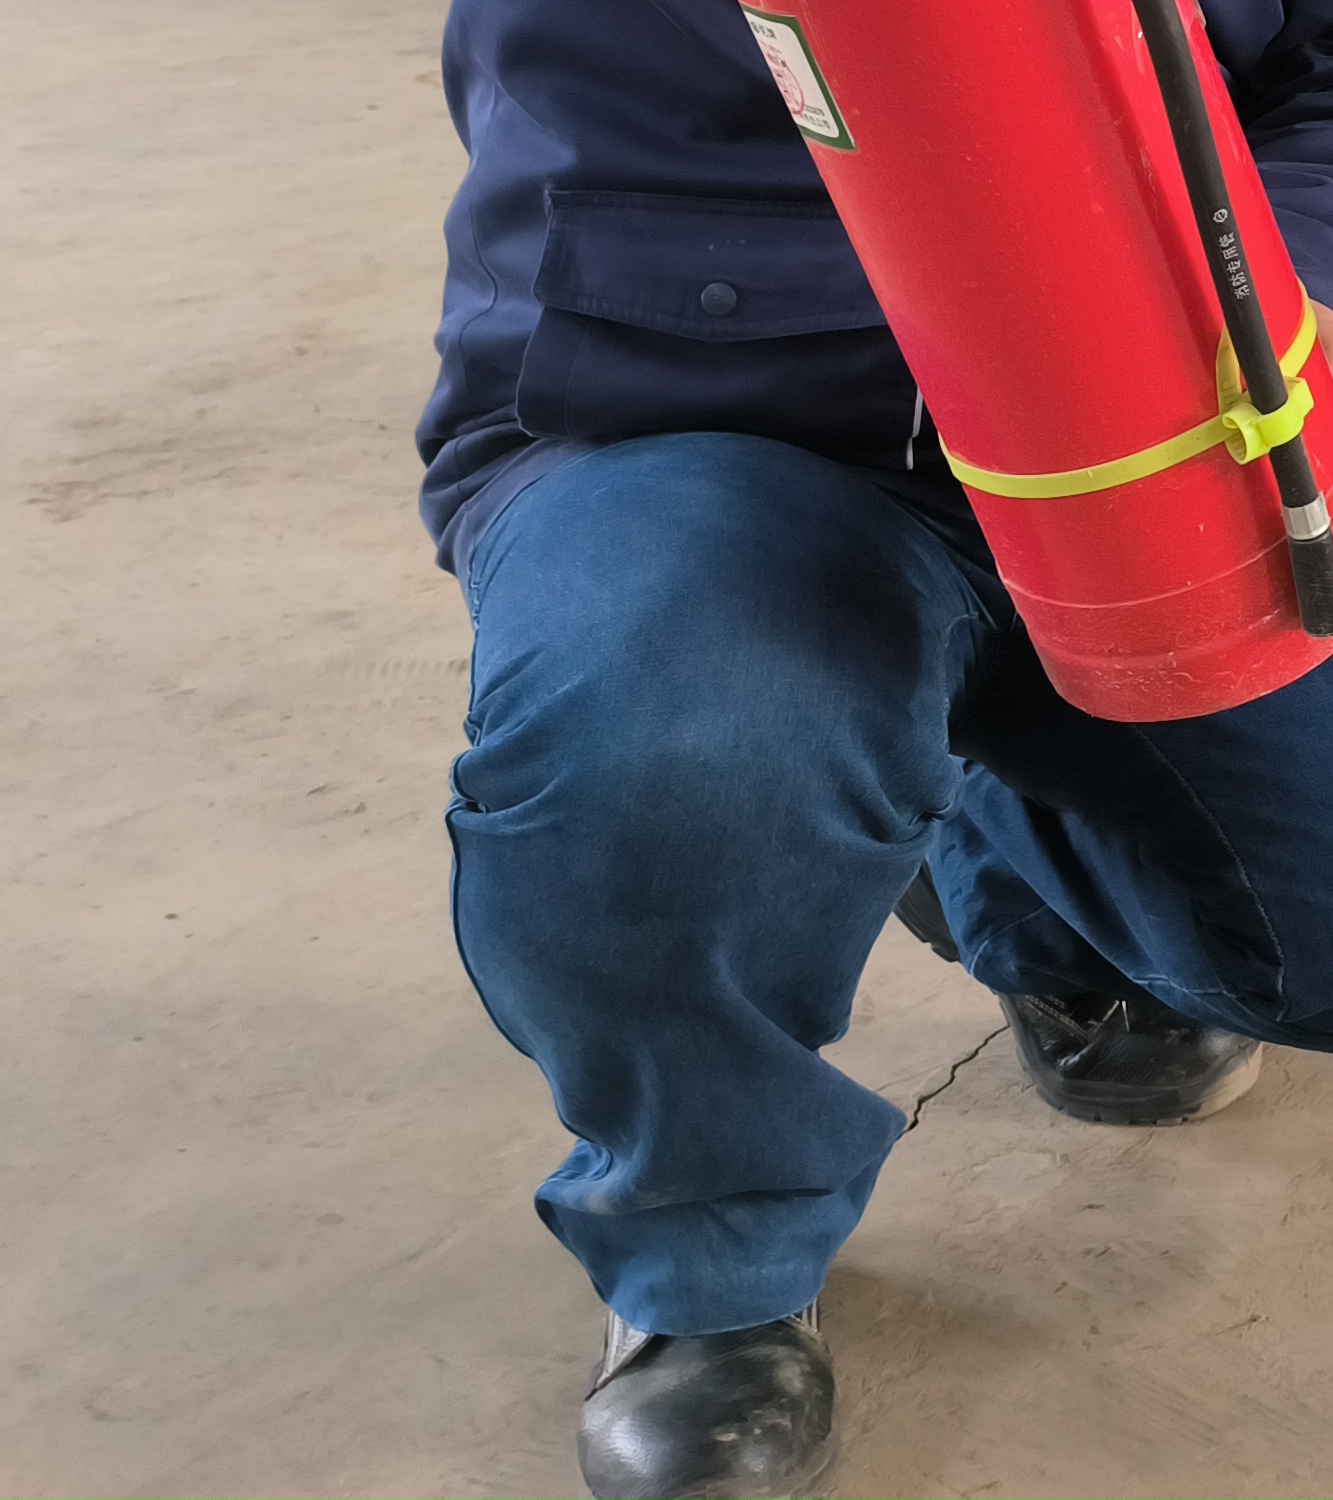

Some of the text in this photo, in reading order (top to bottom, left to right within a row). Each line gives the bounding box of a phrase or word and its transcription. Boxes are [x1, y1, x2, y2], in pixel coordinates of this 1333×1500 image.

[1218, 231, 1250, 300] 消防专用管
